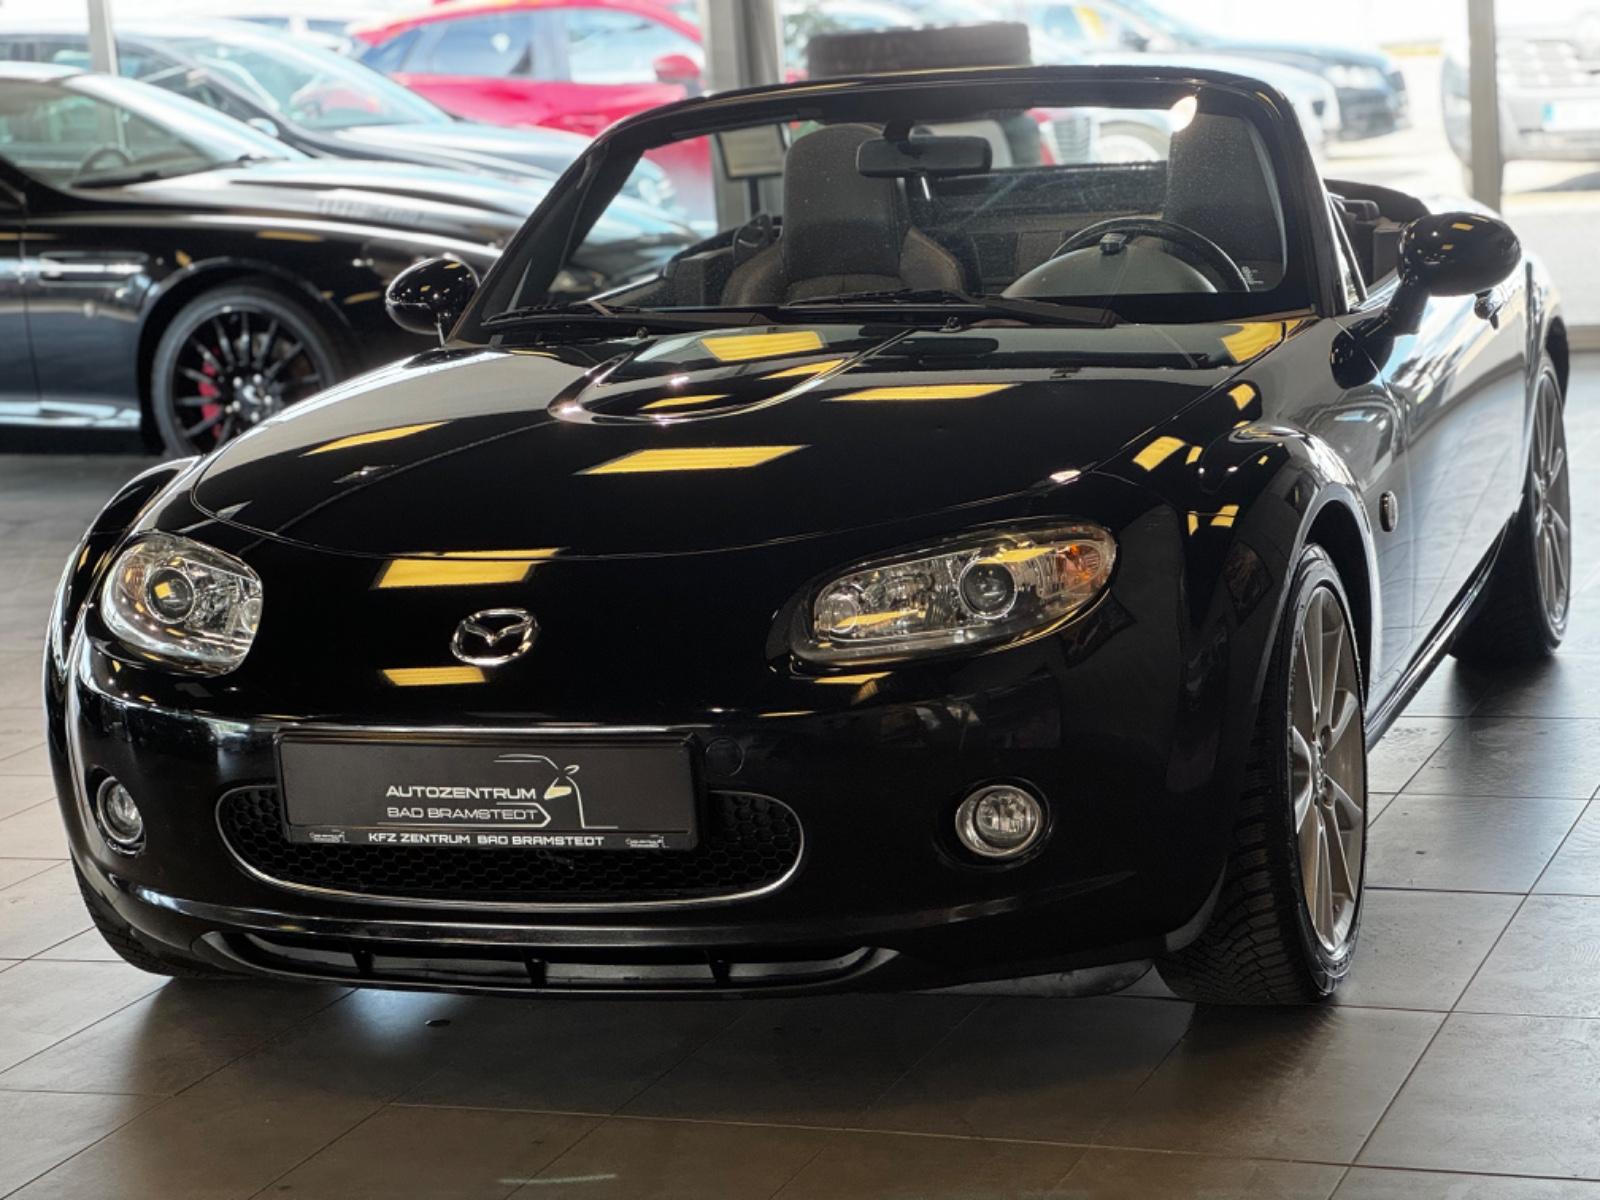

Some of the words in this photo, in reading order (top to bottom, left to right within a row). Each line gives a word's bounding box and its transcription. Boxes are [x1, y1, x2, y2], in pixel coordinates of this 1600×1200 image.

[386, 785, 537, 800] AUTOZENTRUM
[387, 807, 424, 819] BAD
[428, 807, 538, 821] BRAMSTEDT
[368, 832, 398, 843] KFZ
[400, 833, 471, 845] ZENTRUM
[477, 835, 509, 846] BAD
[512, 835, 605, 848] BRAMSTEDT
